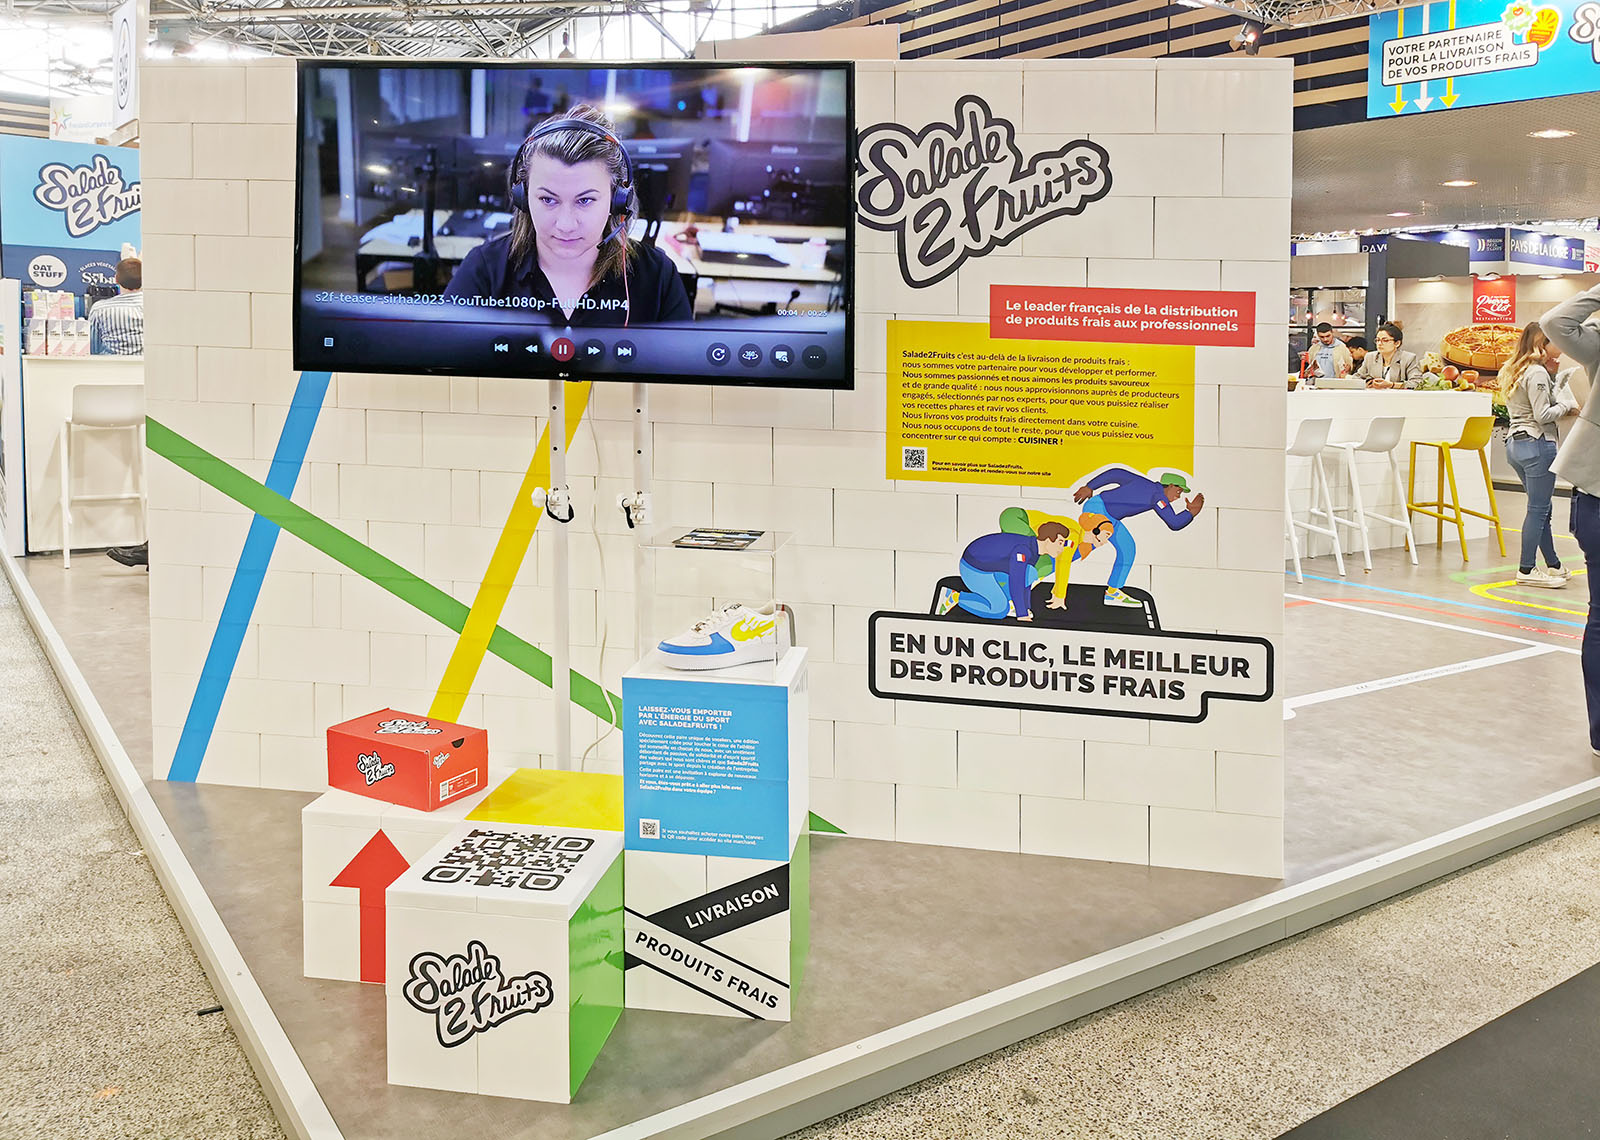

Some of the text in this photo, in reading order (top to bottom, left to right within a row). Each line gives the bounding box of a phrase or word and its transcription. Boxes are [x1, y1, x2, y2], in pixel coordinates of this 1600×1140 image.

[1388, 30, 1502, 56] VOTRE PARTENAIRE
[1388, 42, 1504, 67] POUR LA LIVRAISON
[1388, 50, 1530, 78] DE VOS PRODUITS FRAIS
[859, 111, 1007, 216] Salade
[44, 161, 118, 204] Salade
[1511, 239, 1528, 253] PAYS
[1529, 242, 1538, 255] DE
[1540, 243, 1548, 256] LA
[1006, 300, 1238, 316] Le leader français de la distribution
[1005, 314, 1238, 331] de produits frais aux professionnels
[902, 350, 955, 359] Salade2Fruits
[957, 352, 974, 360] c'est
[1074, 357, 1106, 365] produits
[902, 370, 922, 378] Nous
[957, 373, 999, 381] passionnés
[1061, 376, 1072, 384] les
[1058, 366, 1102, 375] développer
[1115, 368, 1156, 377] performer.
[911, 381, 921, 389] de
[923, 382, 949, 390] grande
[951, 383, 977, 391] qualité
[1025, 386, 1089, 395] approvisionnons
[1119, 389, 1129, 397] de
[1131, 390, 1179, 399] producteurs
[902, 392, 934, 400] engagés,
[937, 392, 984, 401] sélectionnés
[1016, 396, 1047, 404] experts,
[1069, 398, 1084, 406] que
[1106, 399, 1137, 408] puissiez
[1140, 400, 1168, 409] réaliser
[949, 403, 974, 411] phares
[986, 404, 1004, 412] ravir
[1020, 406, 1047, 414] clients.
[902, 411, 921, 419] Nous
[924, 412, 948, 420] livrons
[966, 414, 997, 422] produits
[1000, 414, 1016, 423] frais
[1018, 416, 1064, 425] directement
[1067, 418, 1085, 426] dans
[1110, 420, 1137, 428] cuisine.
[902, 421, 922, 429] Nous
[944, 424, 980, 432] occupons
[982, 424, 992, 432] de
[1012, 425, 1019, 434] le
[1044, 428, 1062, 436] pour
[1102, 430, 1133, 438] puissiez
[901, 432, 942, 440] concentrer
[968, 434, 980, 442] qui
[1016, 436, 1059, 445] CUISINER
[891, 633, 1249, 677] EN UN CLIC, LE MEILLEUR
[890, 660, 1185, 699] DES PRODUITS FRAIS
[639, 706, 691, 714] LAISSEZ-VOUS
[655, 712, 691, 721] L'ÉNERGIE
[685, 884, 779, 929] LIVRAISON
[414, 949, 496, 1004] Salade
[635, 932, 778, 1008] PRODUITS FRAIS
